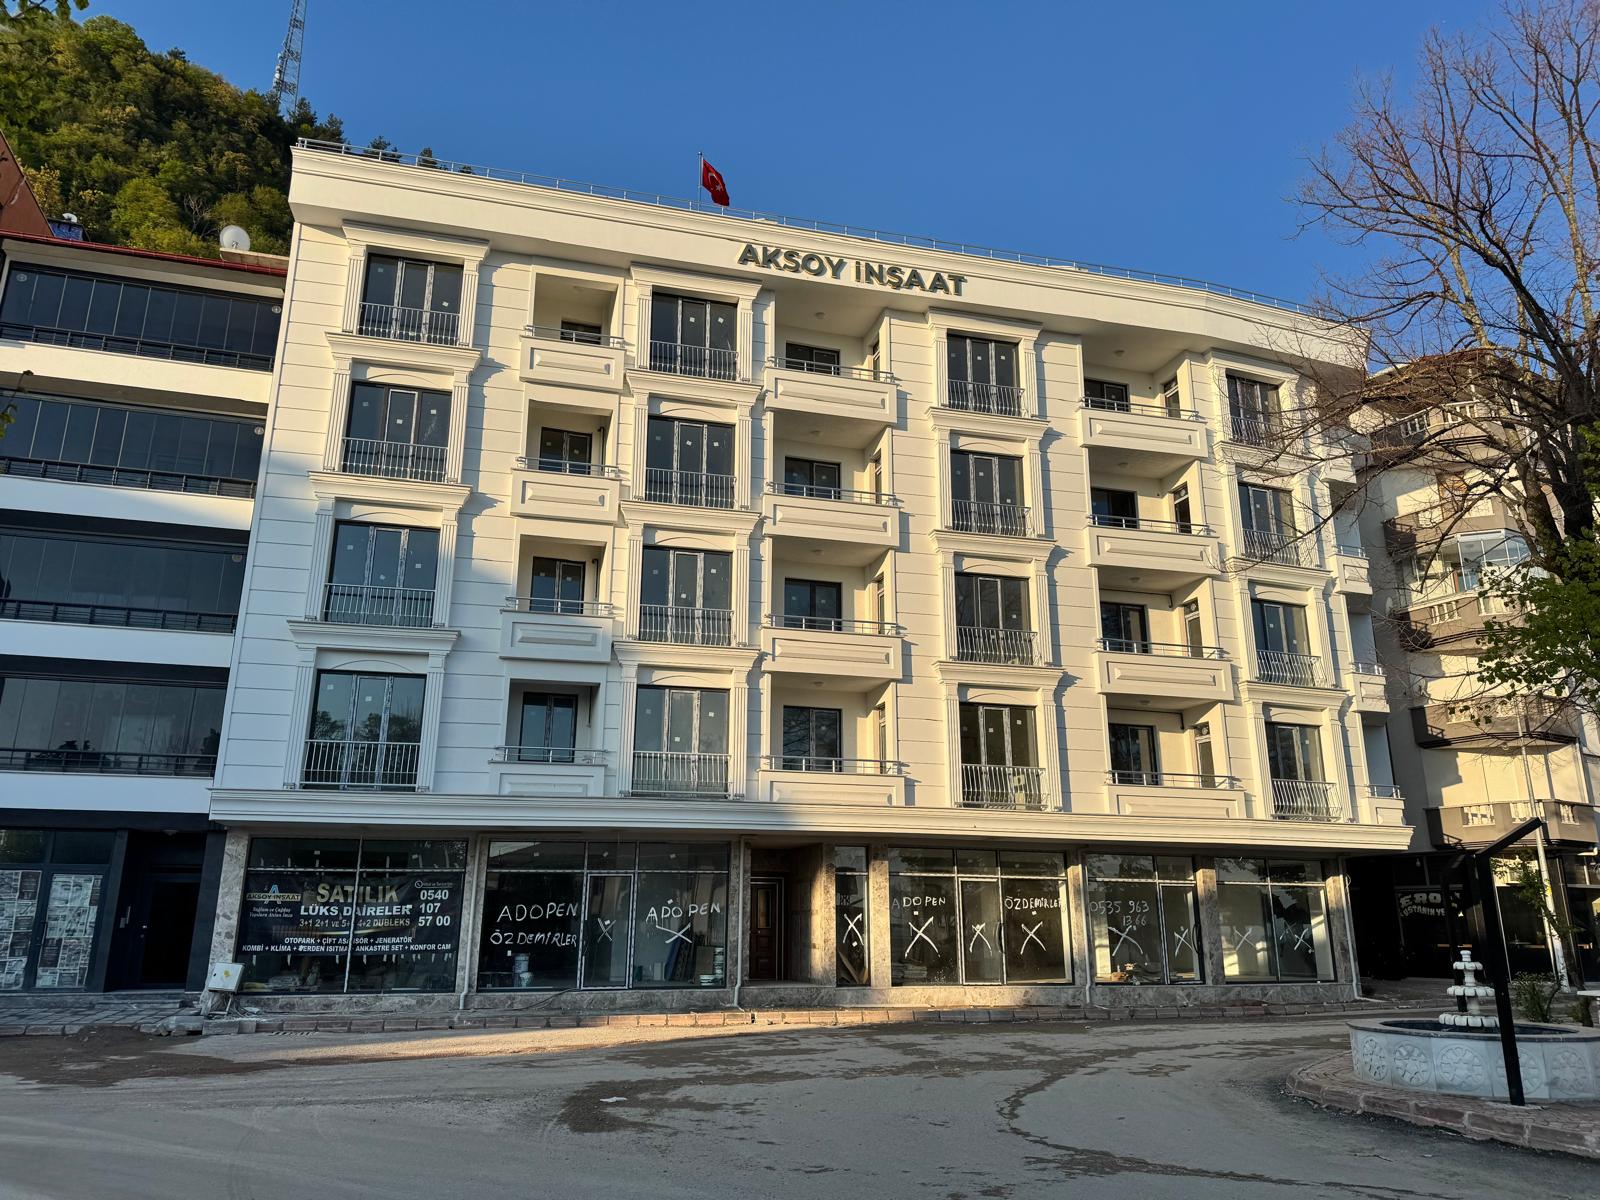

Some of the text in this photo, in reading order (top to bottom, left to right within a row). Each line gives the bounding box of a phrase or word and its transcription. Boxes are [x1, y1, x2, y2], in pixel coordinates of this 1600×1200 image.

[737, 243, 847, 280] AKSOY
[316, 883, 399, 903] SATILIK
[420, 889, 449, 901] 0540
[300, 903, 339, 916] LÜKS
[419, 902, 441, 914] 107
[496, 902, 579, 923] ADOPEN
[1089, 900, 1150, 915] 0535 963
[300, 919, 313, 927] 3+1
[314, 919, 329, 927] 2+1
[418, 915, 451, 927] 57 00
[322, 936, 336, 945] ÇİFT
[338, 936, 368, 944] ASSÖR
[375, 936, 412, 944] JENERATÖR
